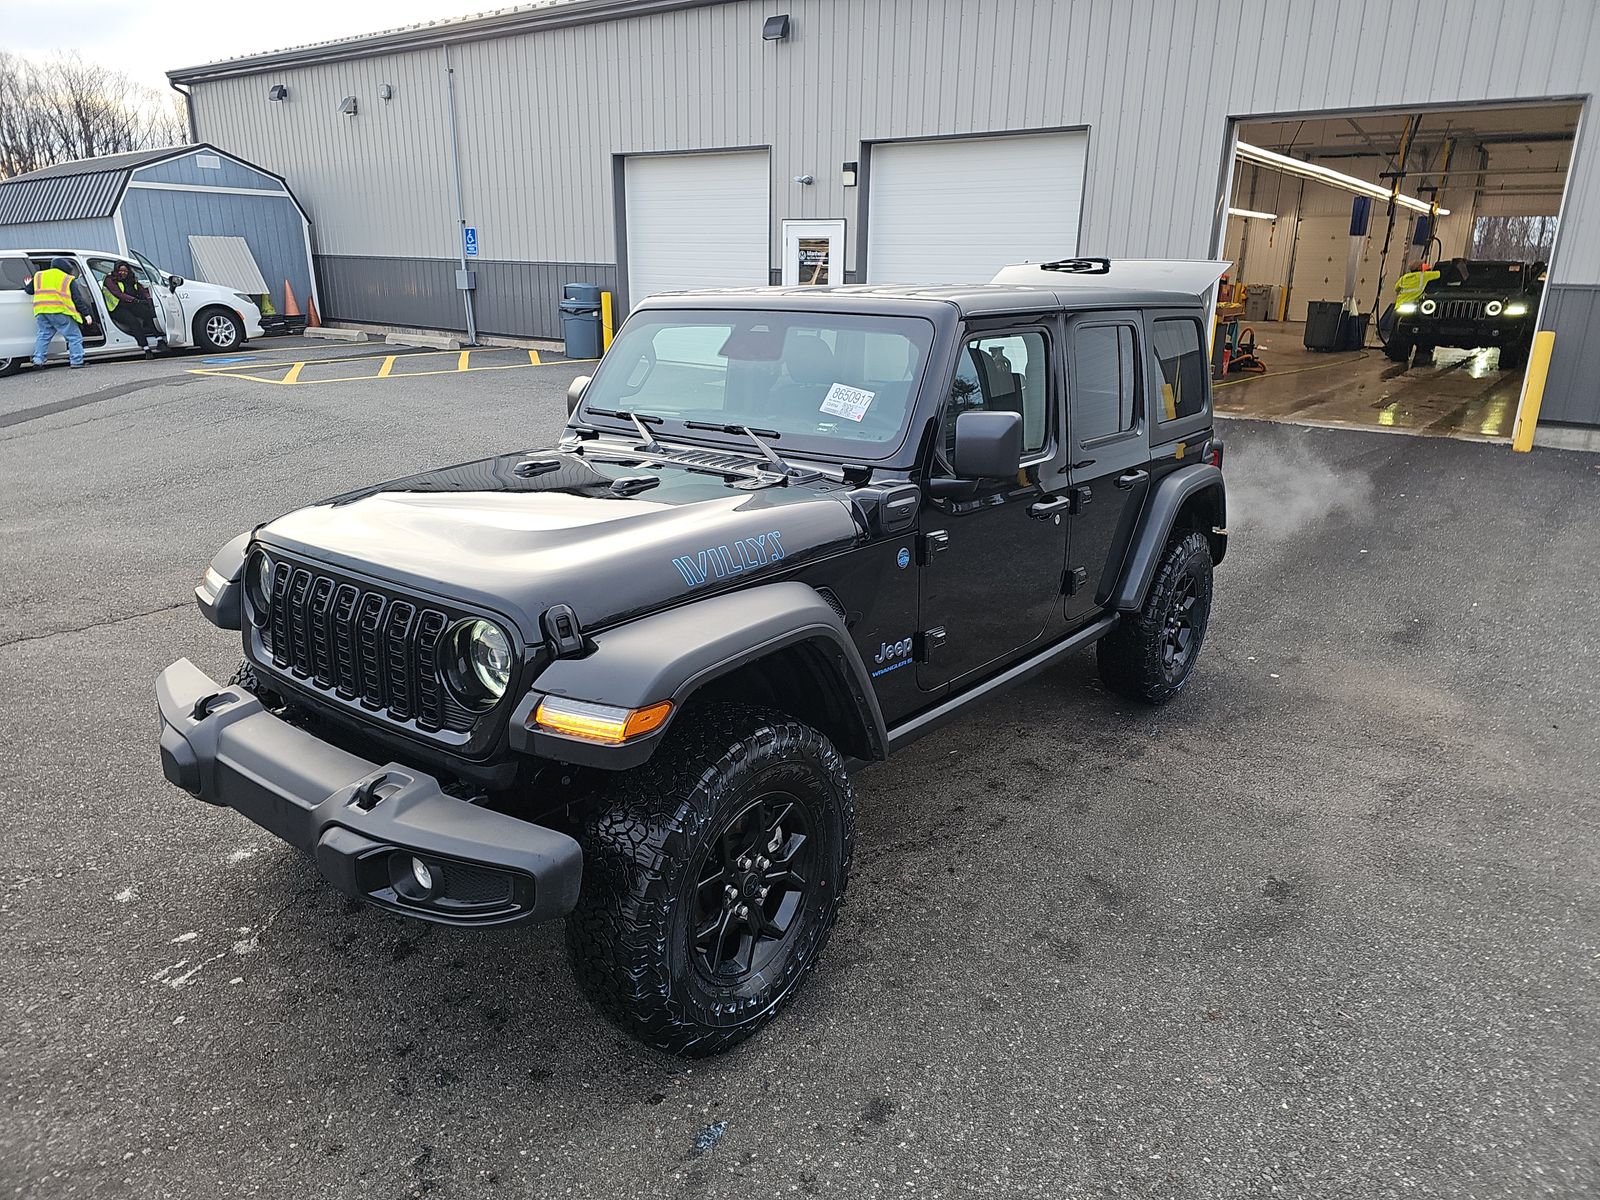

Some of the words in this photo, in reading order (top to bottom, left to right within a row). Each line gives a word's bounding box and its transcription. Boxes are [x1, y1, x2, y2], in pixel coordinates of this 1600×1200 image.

[832, 387, 873, 407] 8650917
[672, 530, 785, 586] WILLYS
[874, 637, 913, 663] Jeep
